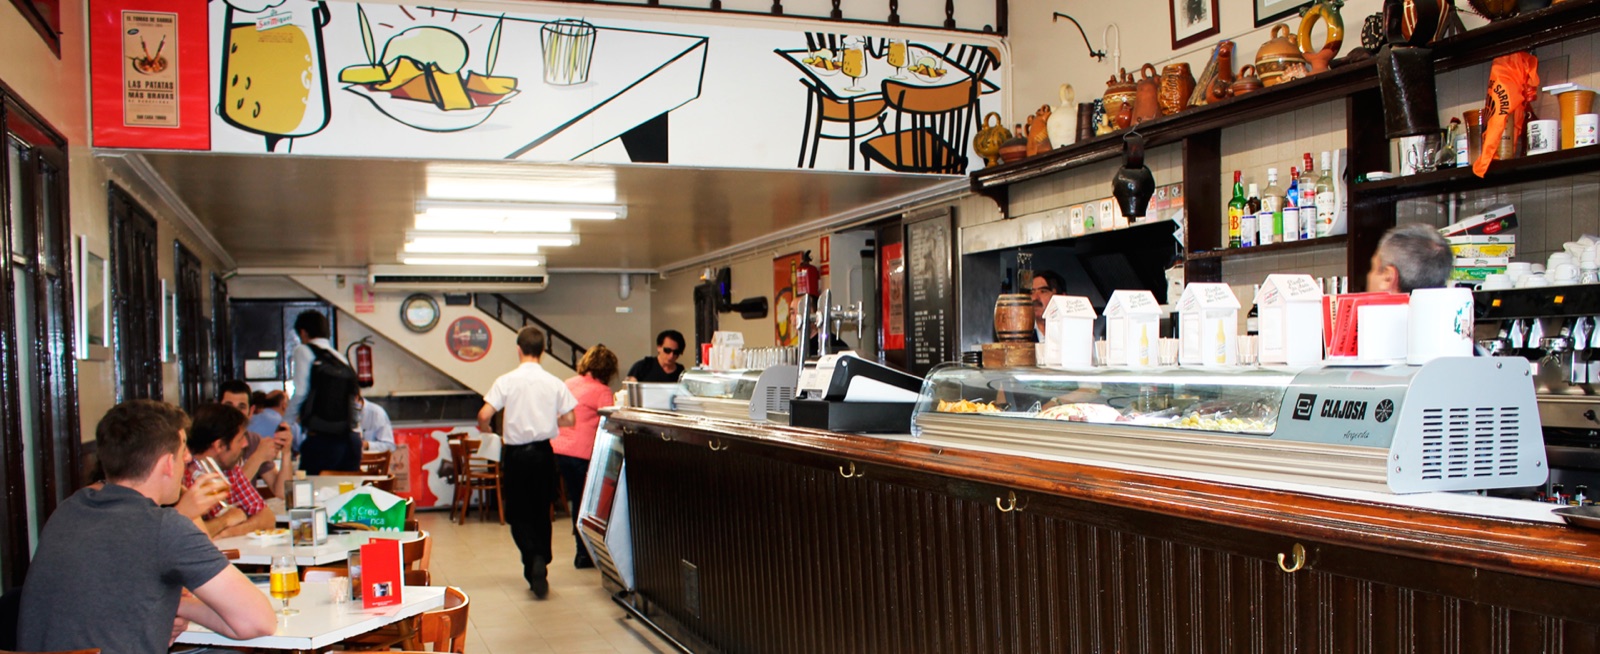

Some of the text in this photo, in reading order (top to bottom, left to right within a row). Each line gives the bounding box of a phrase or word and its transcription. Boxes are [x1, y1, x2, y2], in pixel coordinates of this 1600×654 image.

[128, 80, 173, 89] LAS PATATAS
[147, 92, 174, 100] BRAVAS
[1320, 399, 1368, 420] CLAJOSA
[358, 507, 378, 516] Creu
